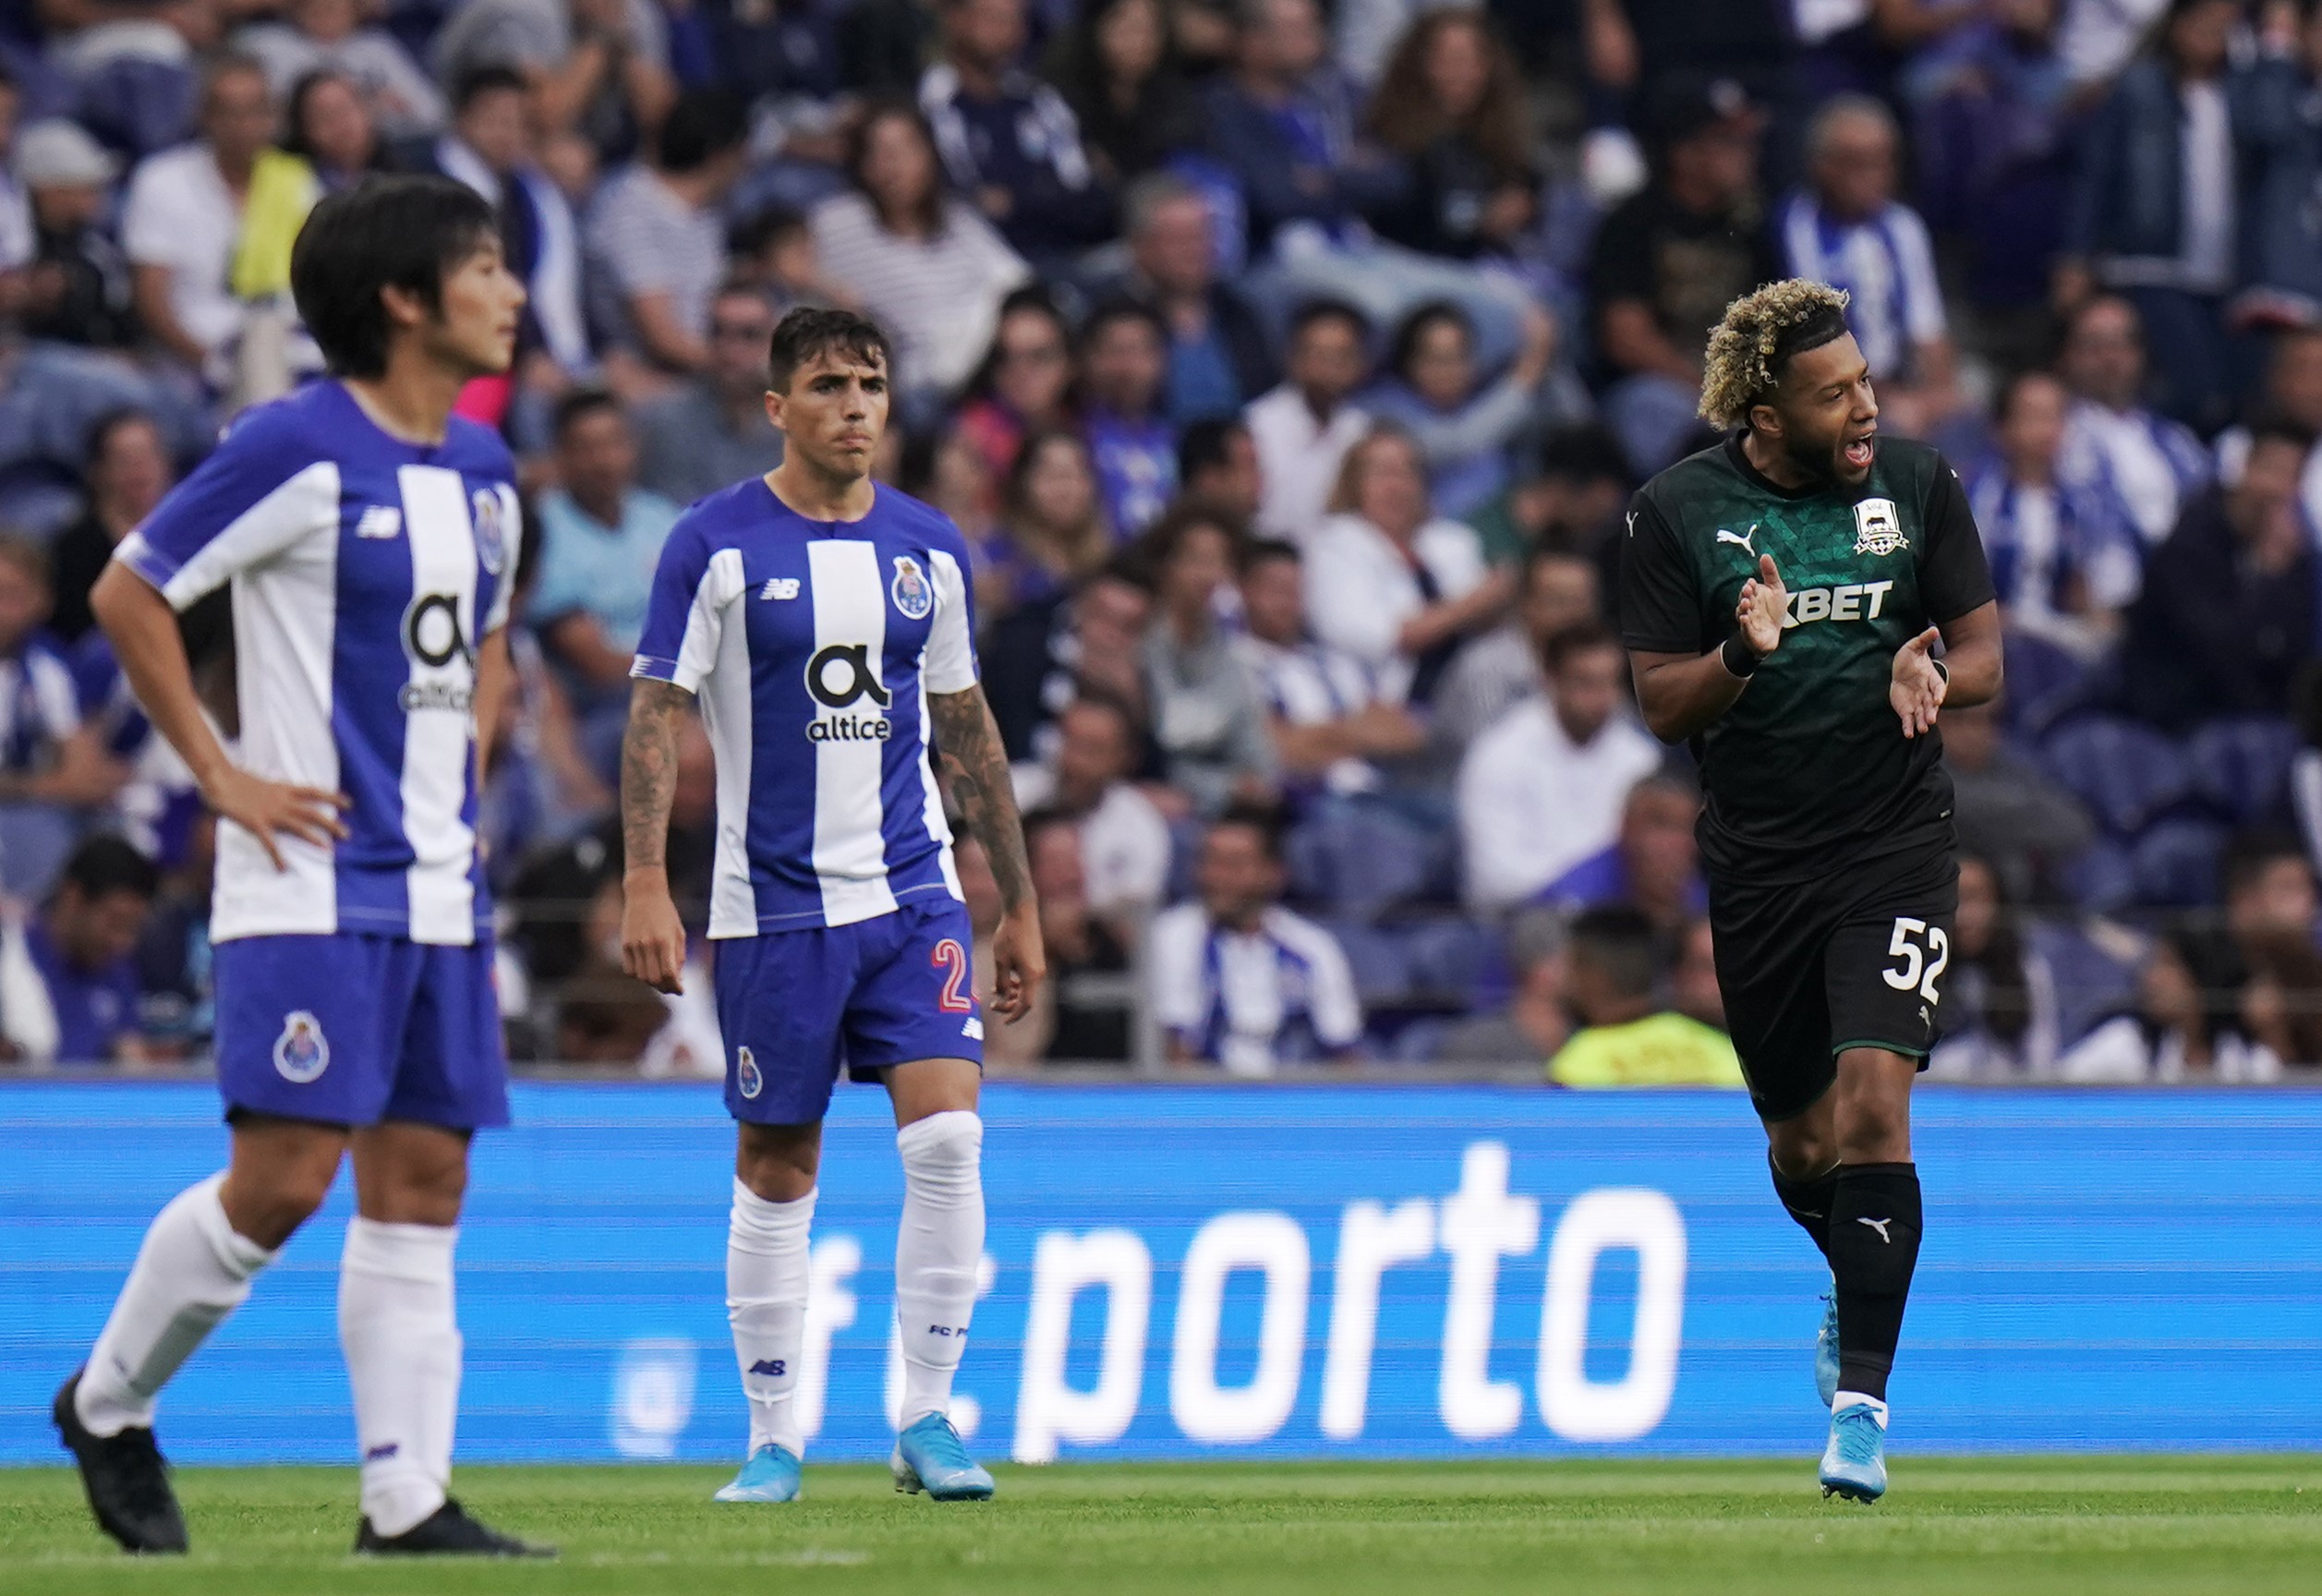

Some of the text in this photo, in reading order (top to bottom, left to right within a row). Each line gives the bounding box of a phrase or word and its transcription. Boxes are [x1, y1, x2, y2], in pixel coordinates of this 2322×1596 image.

[808, 715, 889, 741] altice
[931, 938, 981, 1014] 2
[1881, 916, 1949, 1007] 52
